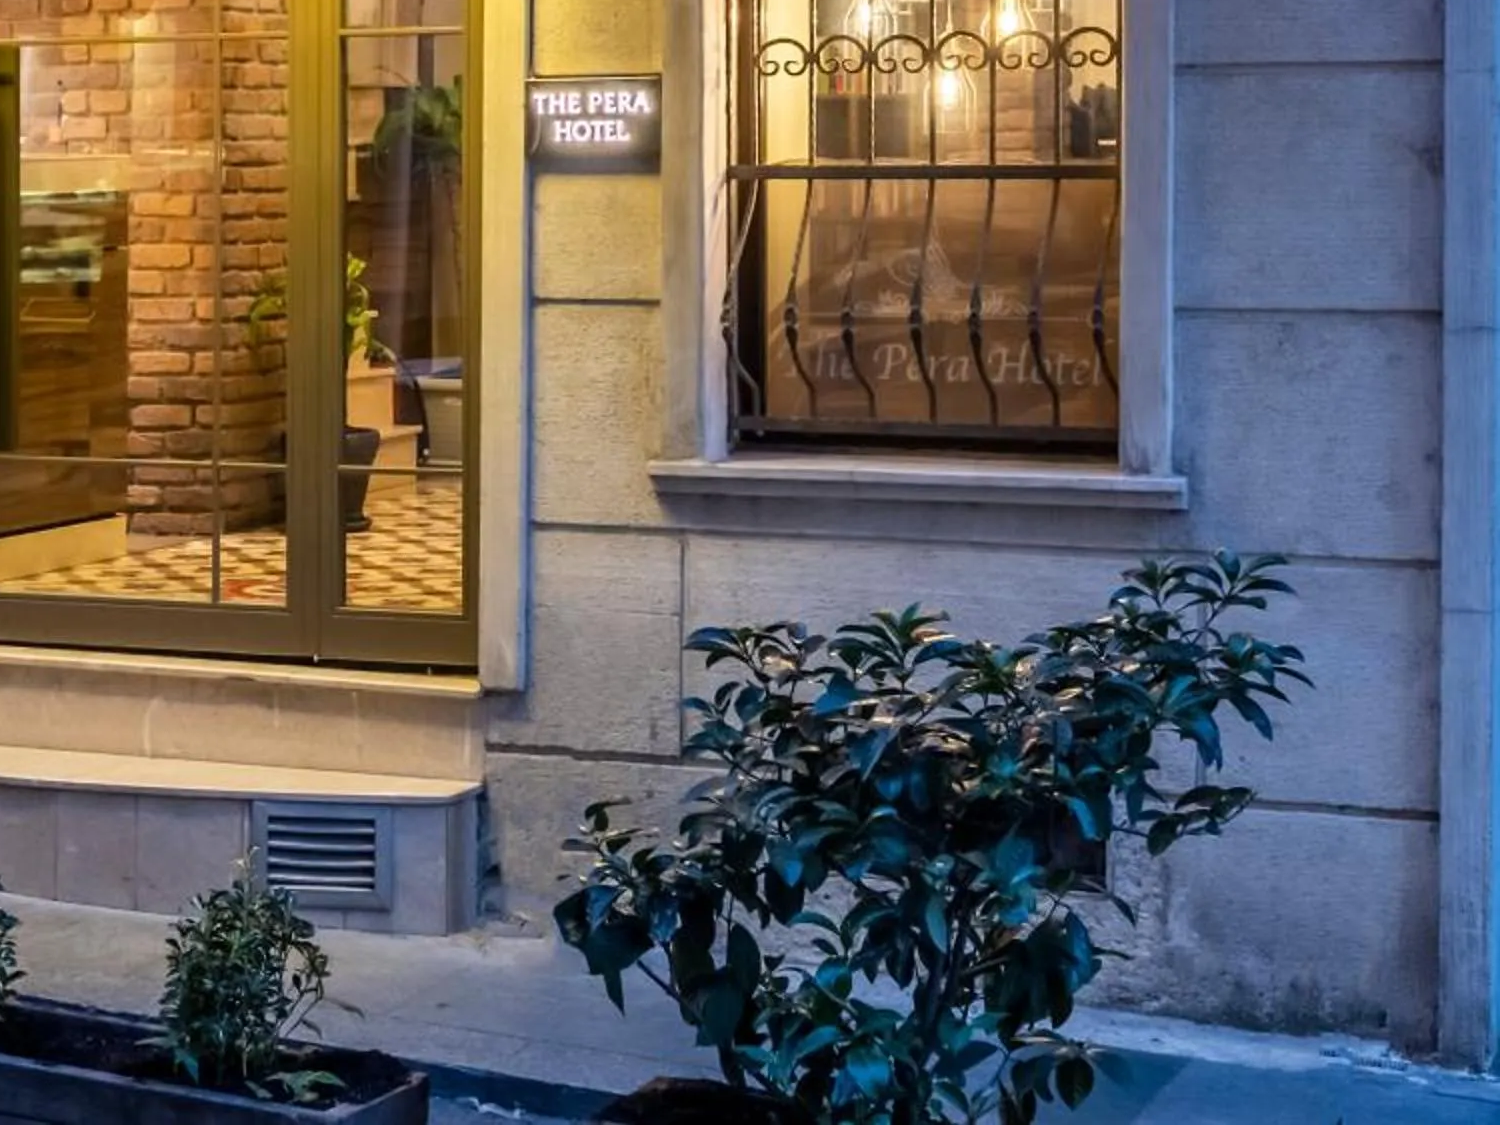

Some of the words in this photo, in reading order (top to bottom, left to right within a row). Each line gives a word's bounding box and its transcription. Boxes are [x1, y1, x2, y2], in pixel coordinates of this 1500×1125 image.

[533, 92, 582, 115] THE
[588, 91, 651, 114] PERA
[553, 120, 631, 142] HOTEL
[873, 343, 970, 383] Pera
